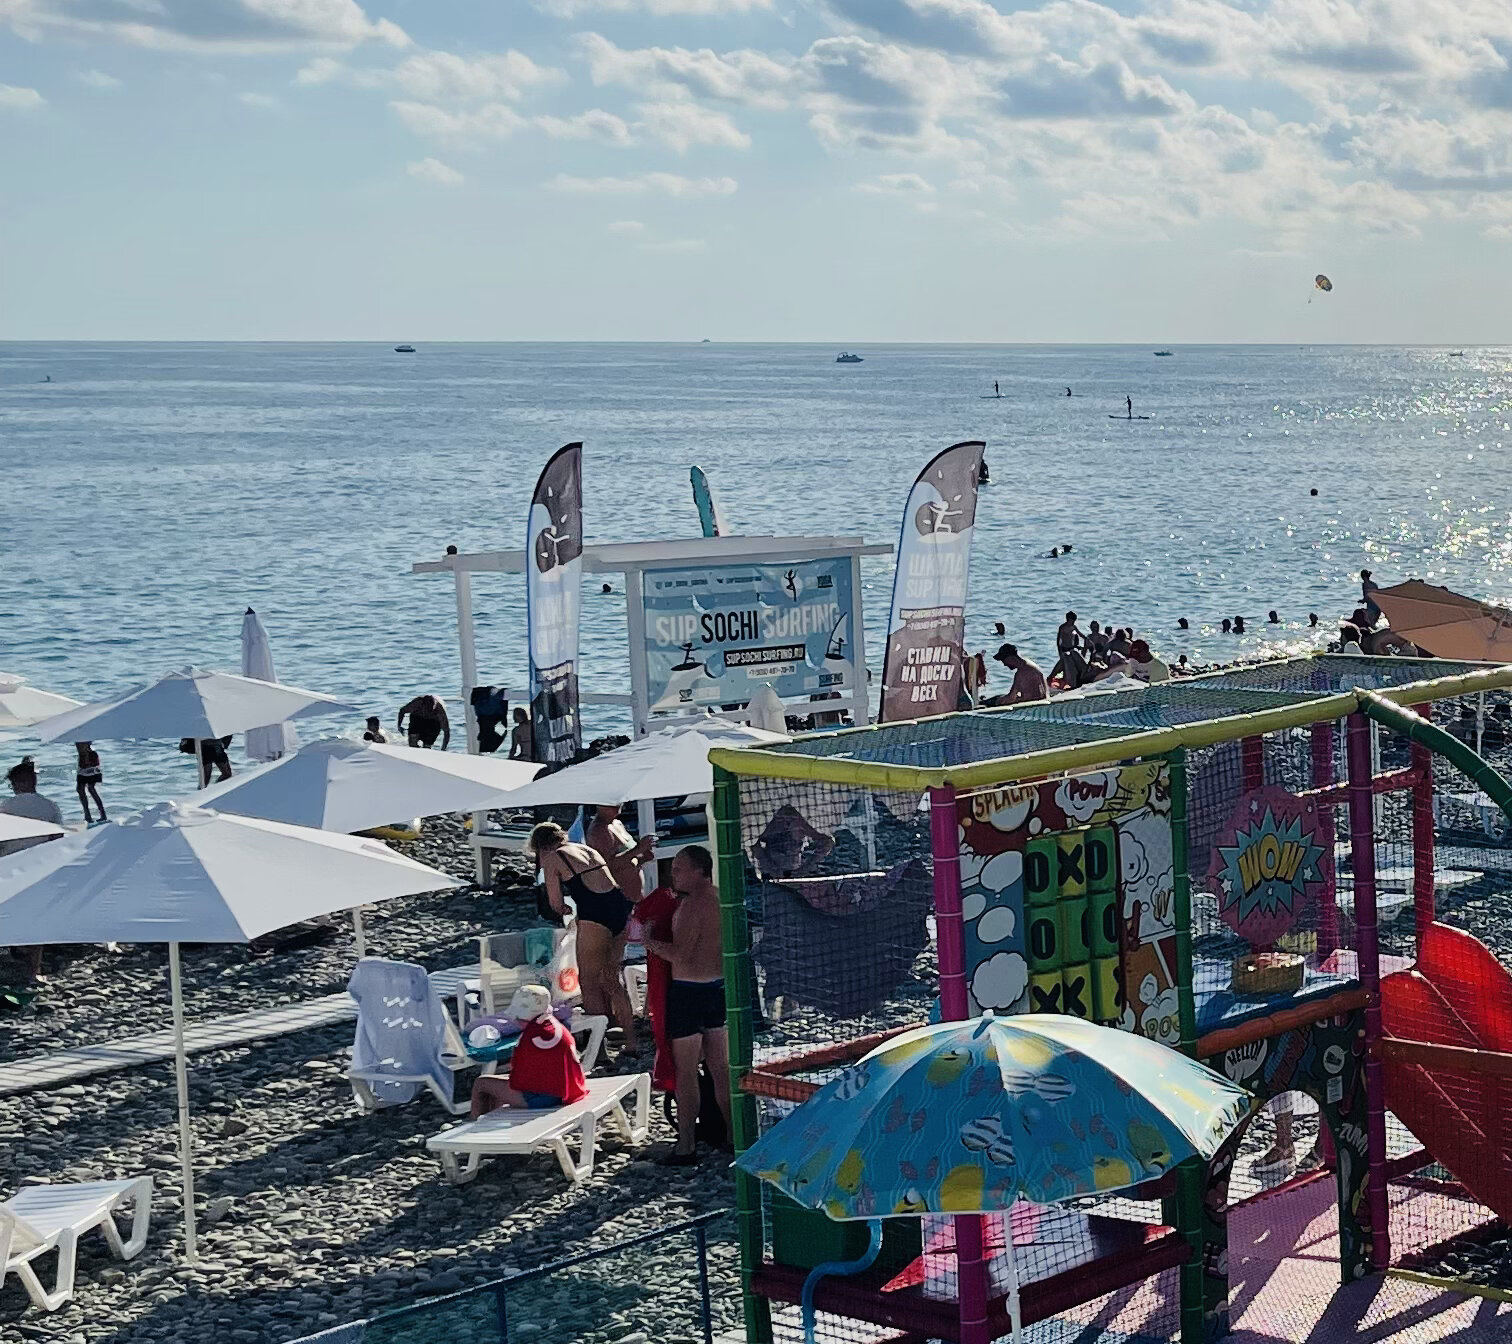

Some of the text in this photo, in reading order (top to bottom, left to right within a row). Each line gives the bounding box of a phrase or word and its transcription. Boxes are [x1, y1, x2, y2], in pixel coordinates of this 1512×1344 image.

[655, 602, 840, 648] SUP SOCHI SURFING
[907, 646, 951, 665] СТАВИМ
[901, 664, 955, 684] НА ДОСКУ
[910, 684, 938, 702] ВСЕХ
[1237, 832, 1307, 898] WOW
